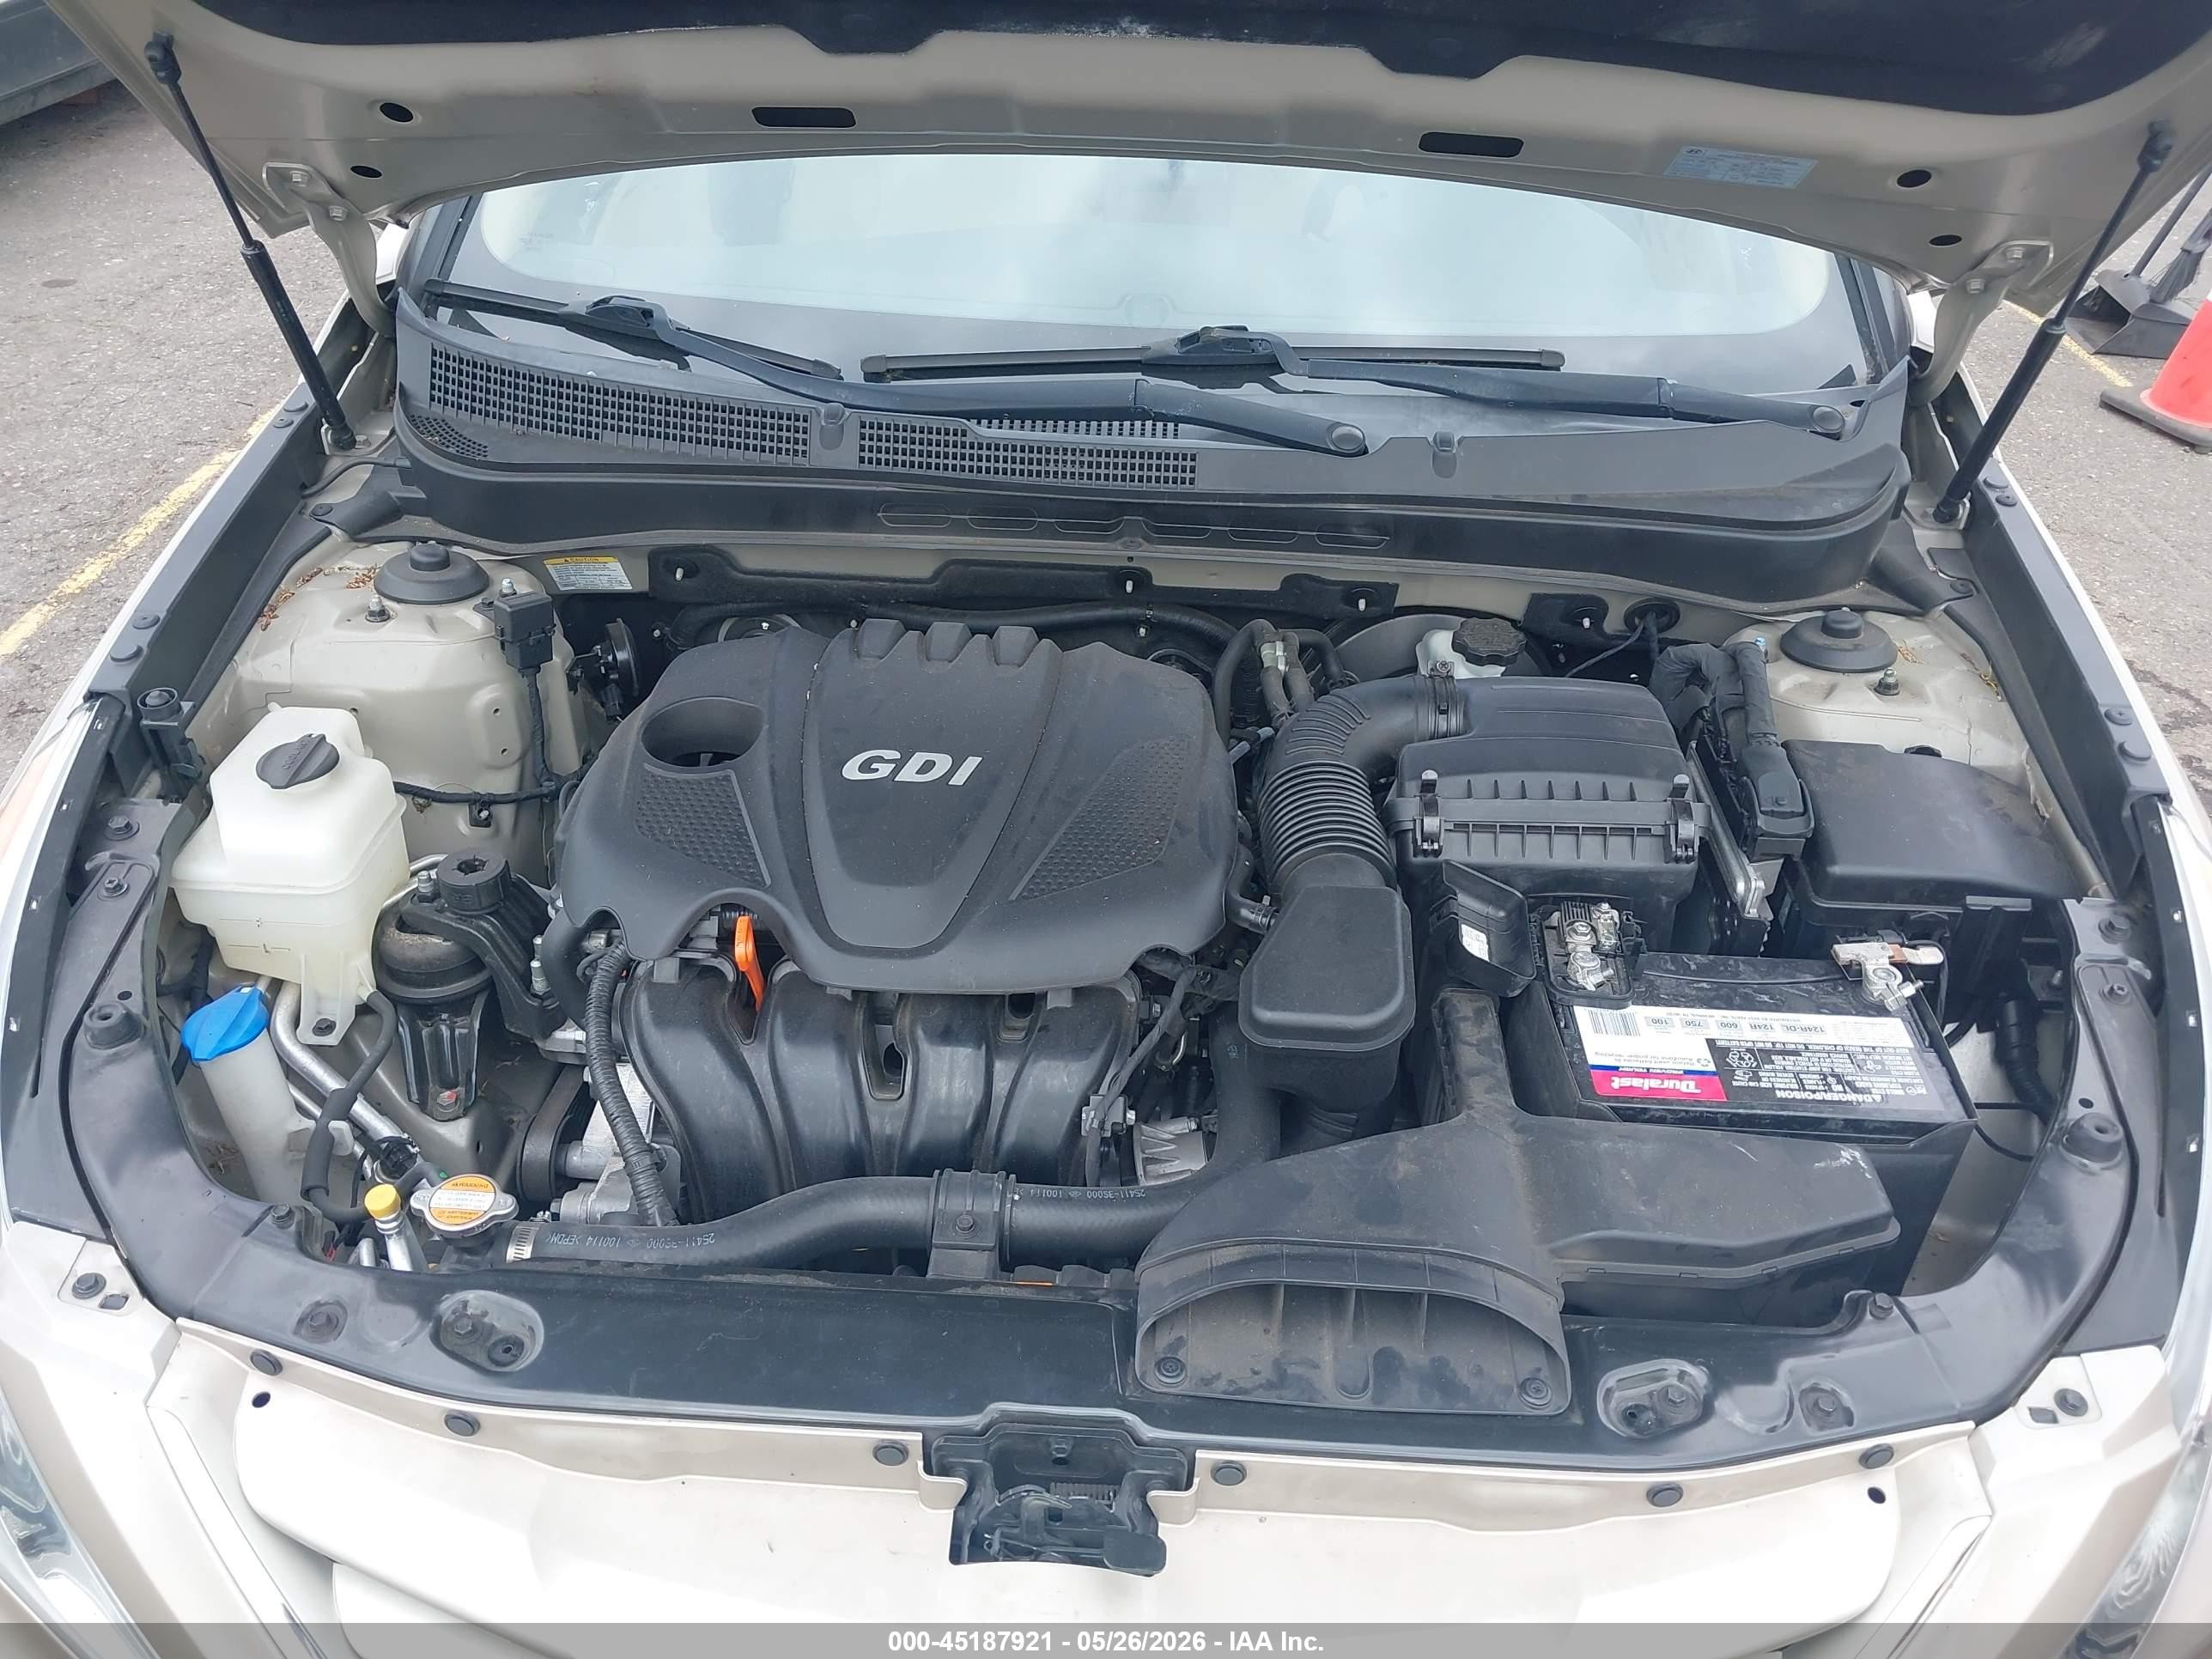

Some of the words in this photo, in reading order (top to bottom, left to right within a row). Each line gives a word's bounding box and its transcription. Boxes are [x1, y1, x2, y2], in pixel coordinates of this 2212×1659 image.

[842, 749, 983, 786] GDI
[1611, 1076, 1702, 1093] Duralast
[1775, 1091, 1874, 1102] DANGER/POISON
[586, 1237, 621, 1248] 100114
